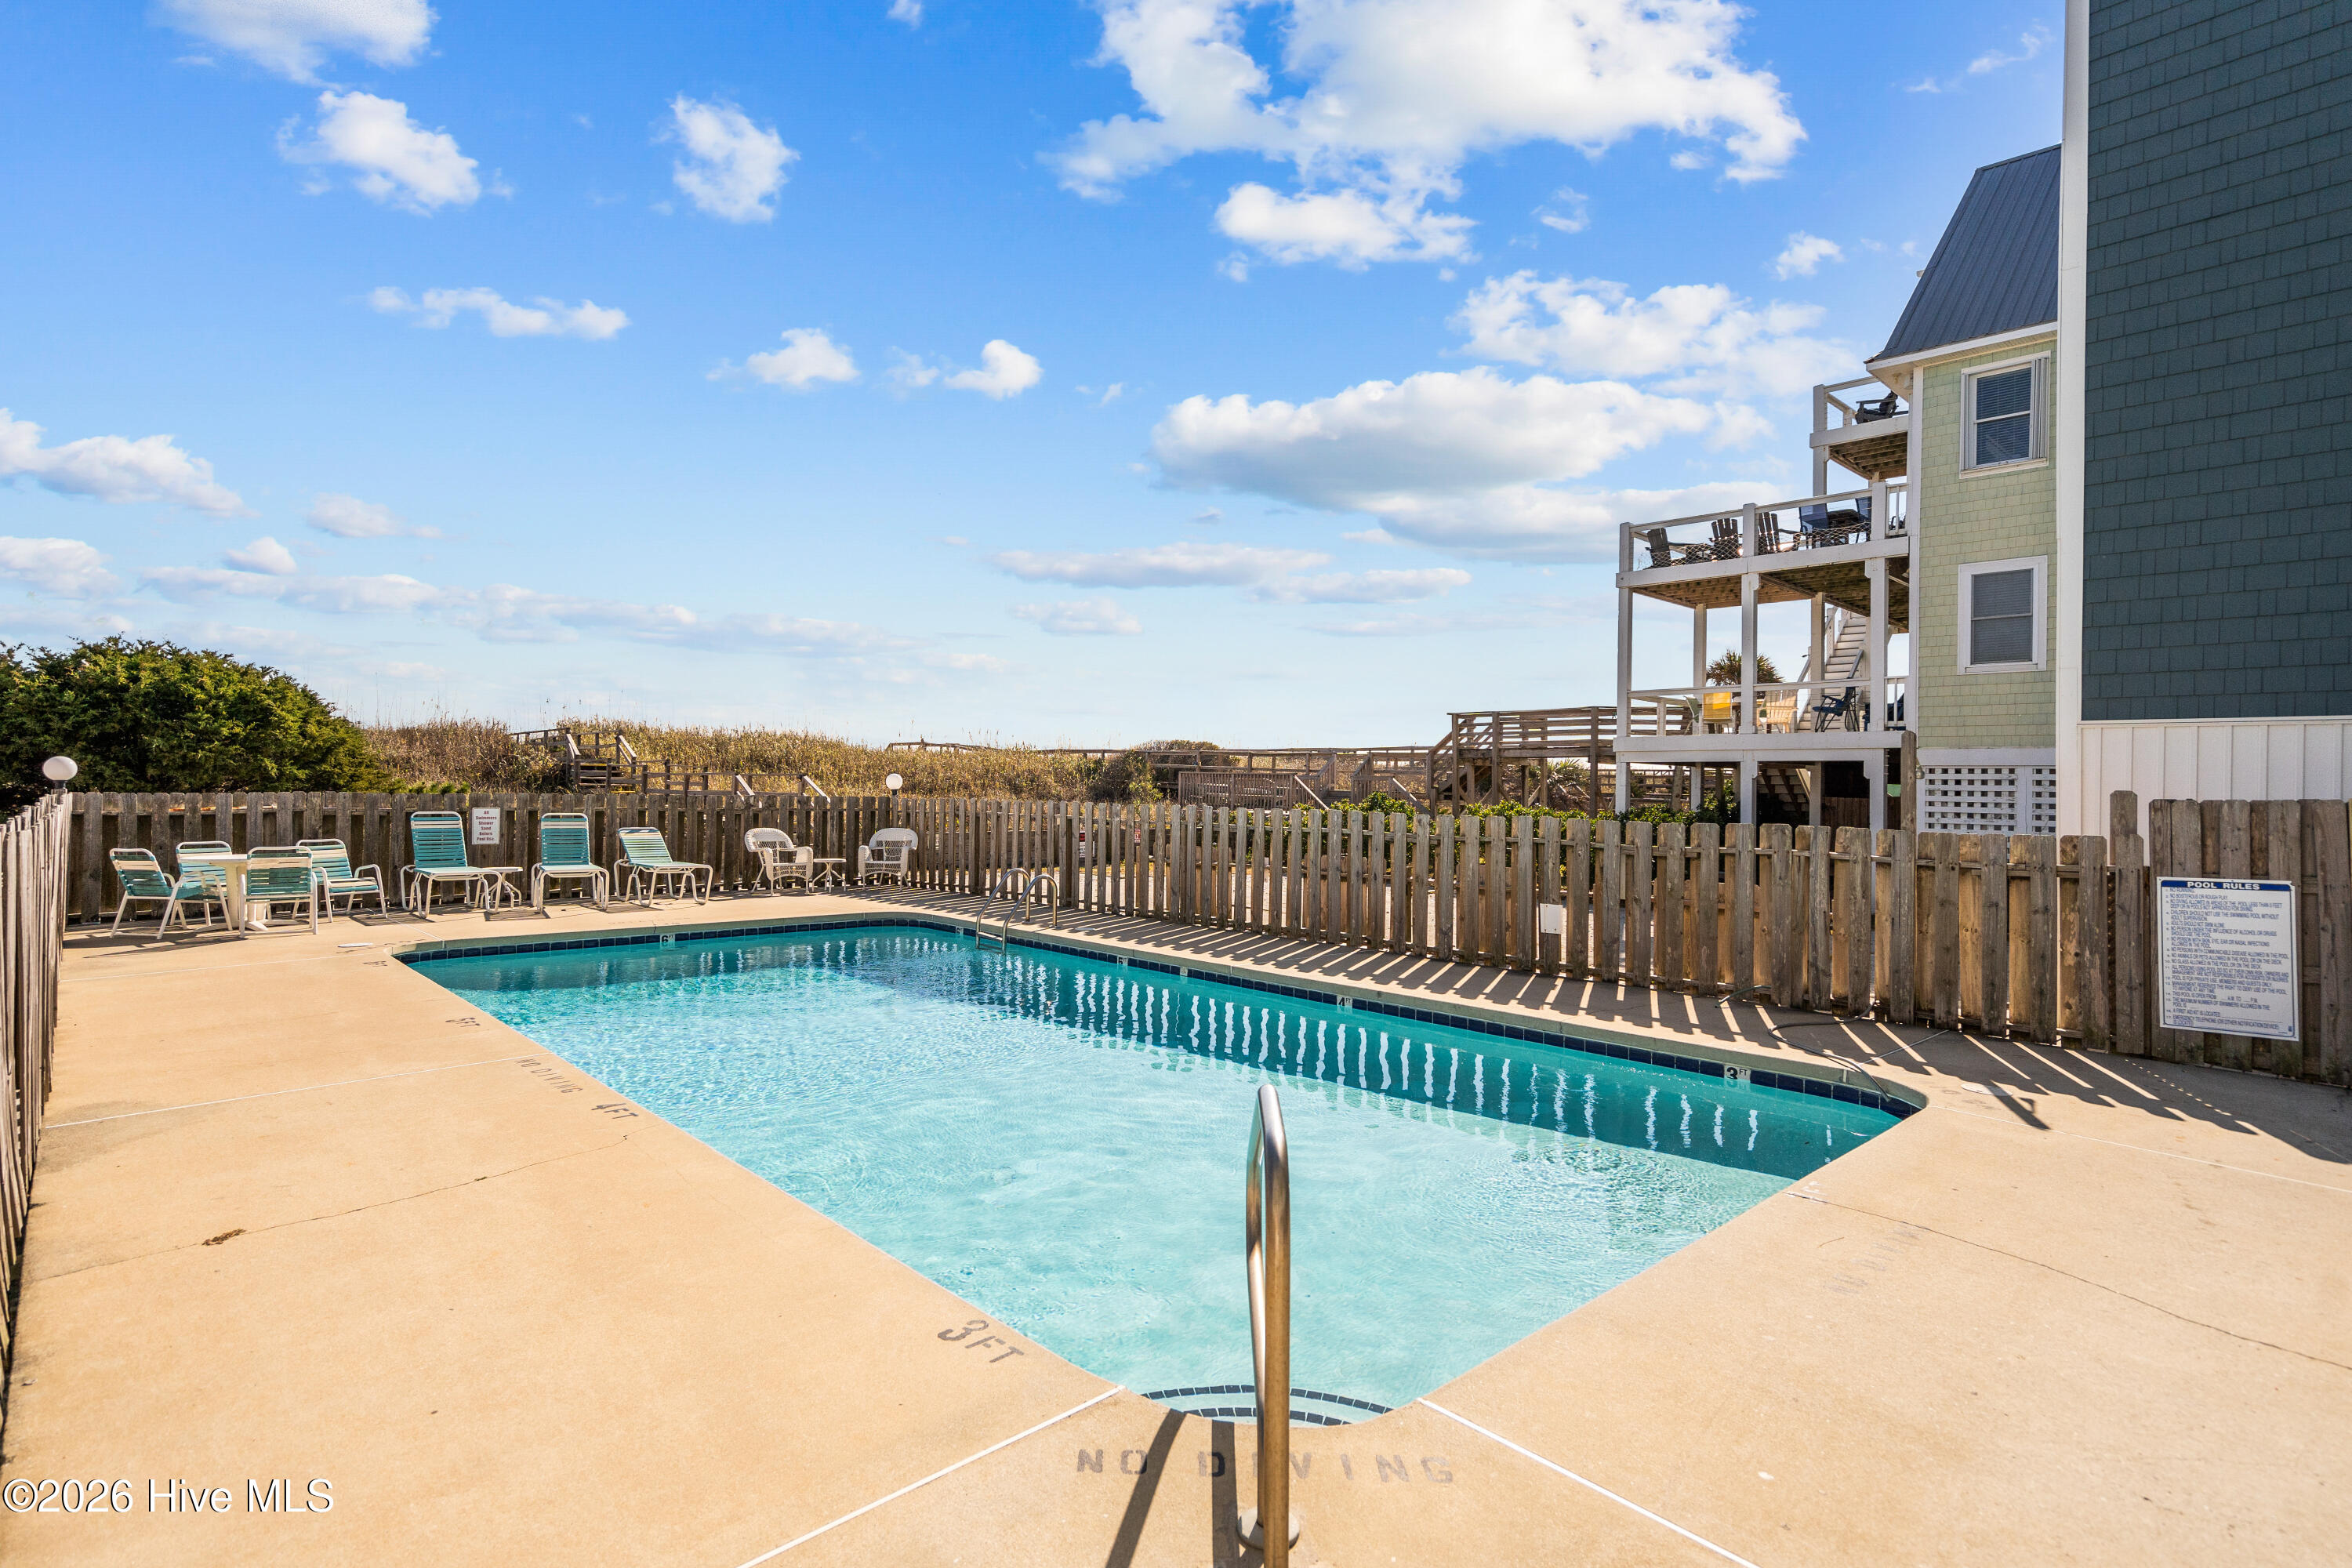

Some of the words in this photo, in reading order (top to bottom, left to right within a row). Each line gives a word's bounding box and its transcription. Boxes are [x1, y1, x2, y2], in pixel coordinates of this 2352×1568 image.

[2223, 882, 2260, 891] RULES
[590, 1102, 639, 1120] 4FT
[938, 1319, 1025, 1363] 3FT
[1076, 1449, 1148, 1475] NO
